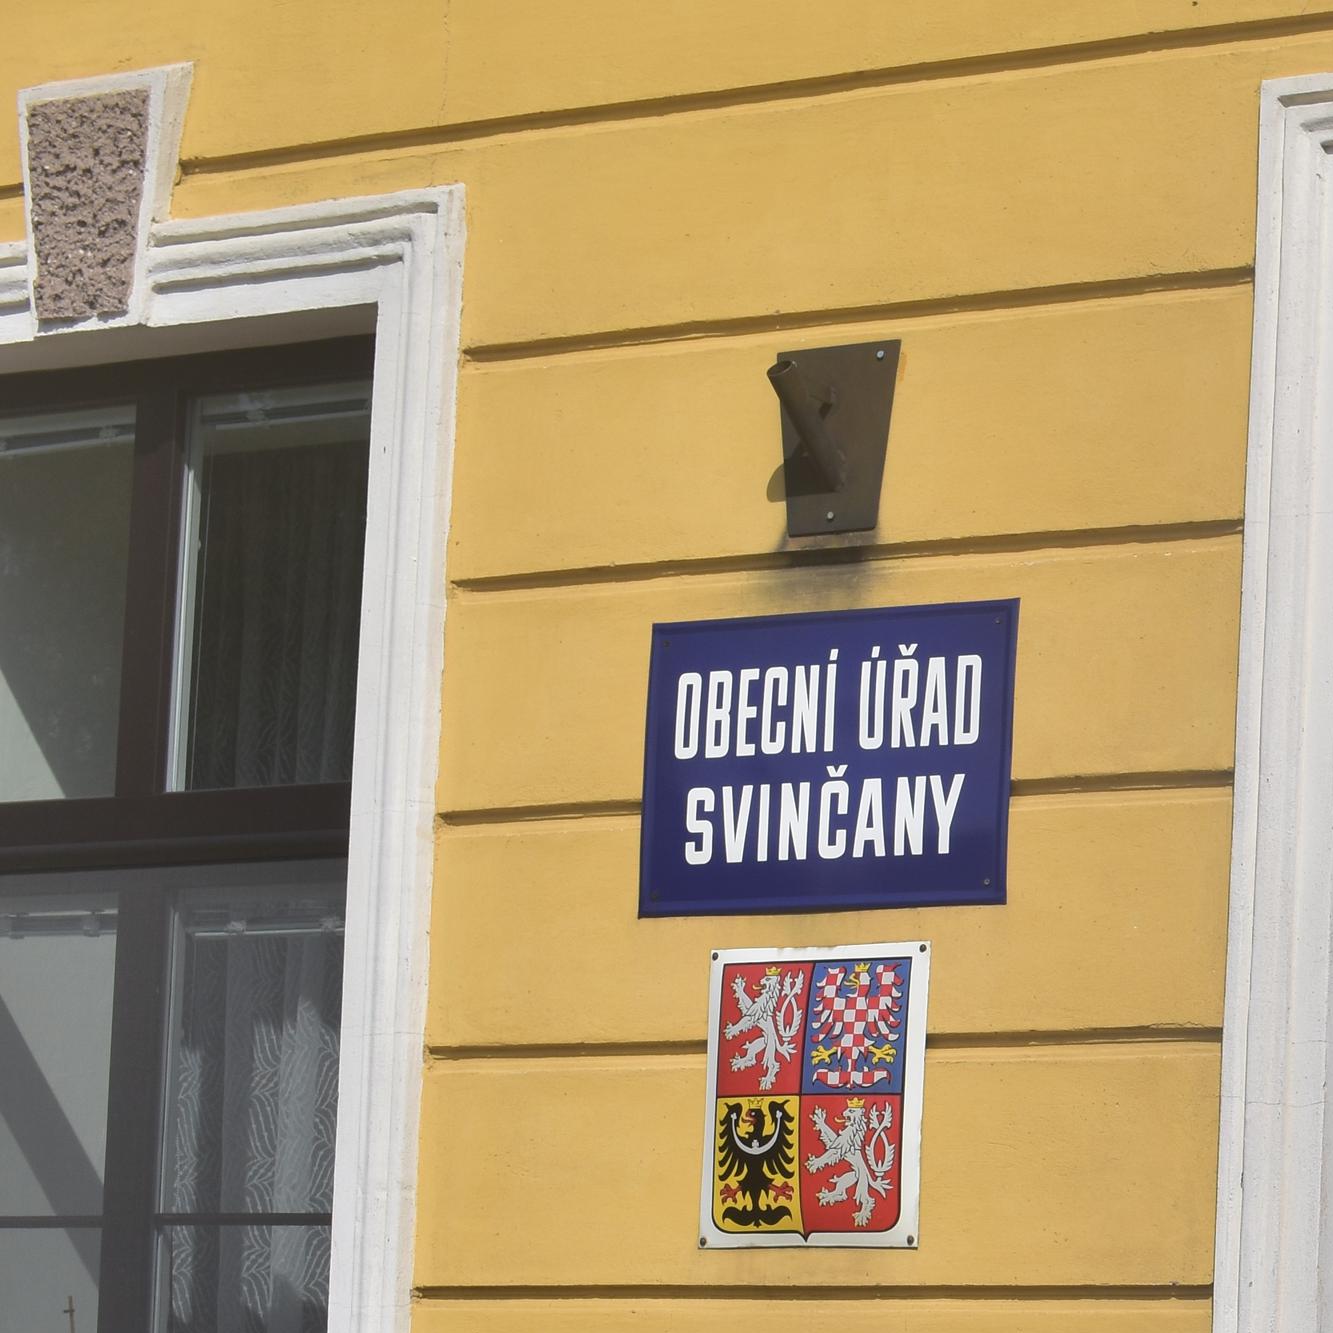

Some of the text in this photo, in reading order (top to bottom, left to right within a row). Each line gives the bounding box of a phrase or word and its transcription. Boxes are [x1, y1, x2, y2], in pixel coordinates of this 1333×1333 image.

[674, 643, 983, 760] OBECNÍ ÚŘAD
[684, 764, 966, 866] SVINČANY
